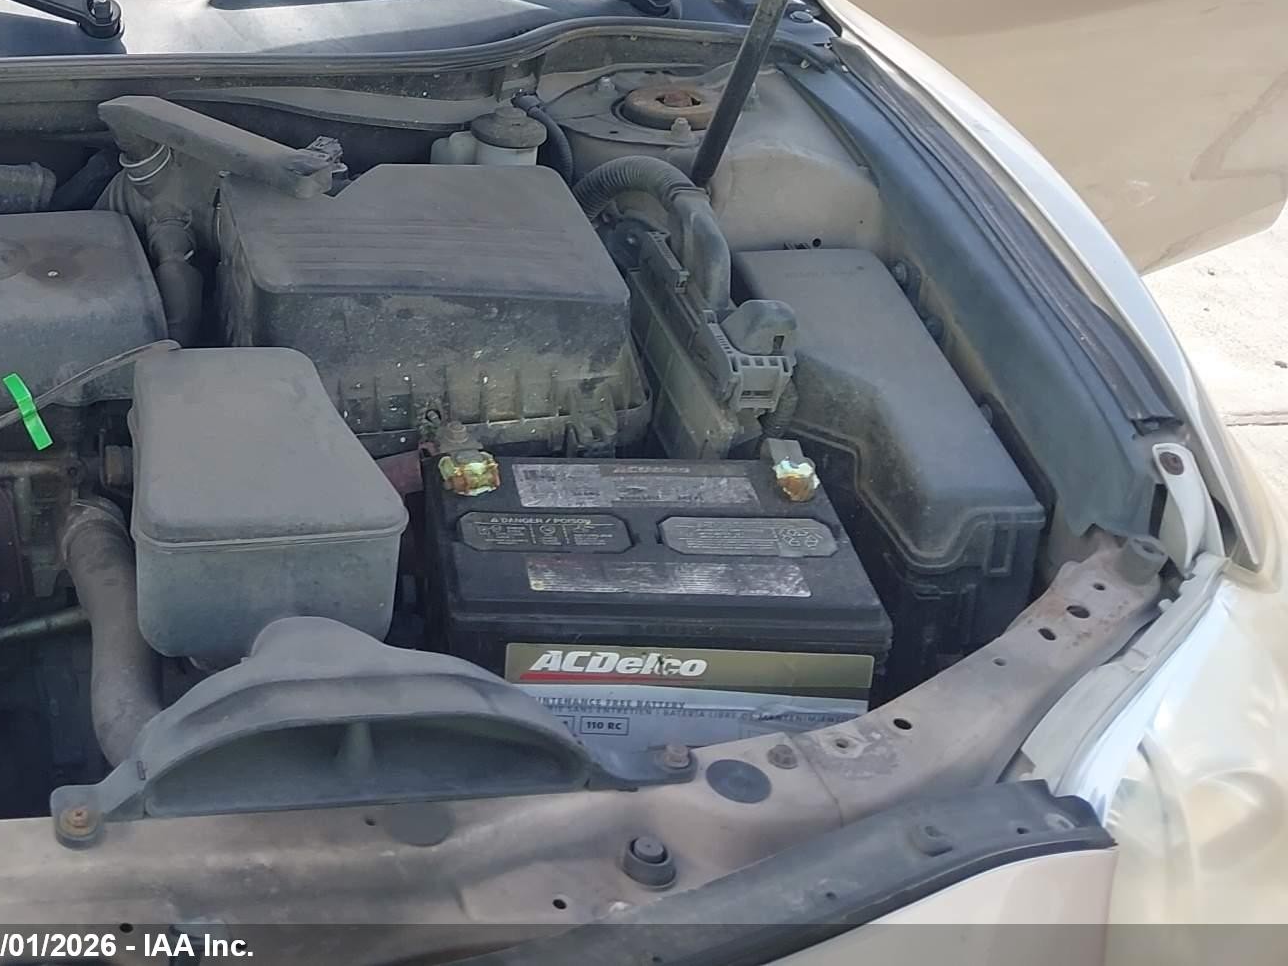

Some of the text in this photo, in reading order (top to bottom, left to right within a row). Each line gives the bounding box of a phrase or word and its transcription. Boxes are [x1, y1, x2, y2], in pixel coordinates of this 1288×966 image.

[528, 650, 708, 677] ACDelco
[637, 700, 686, 710] BATTERY
[586, 721, 604, 730] 110
